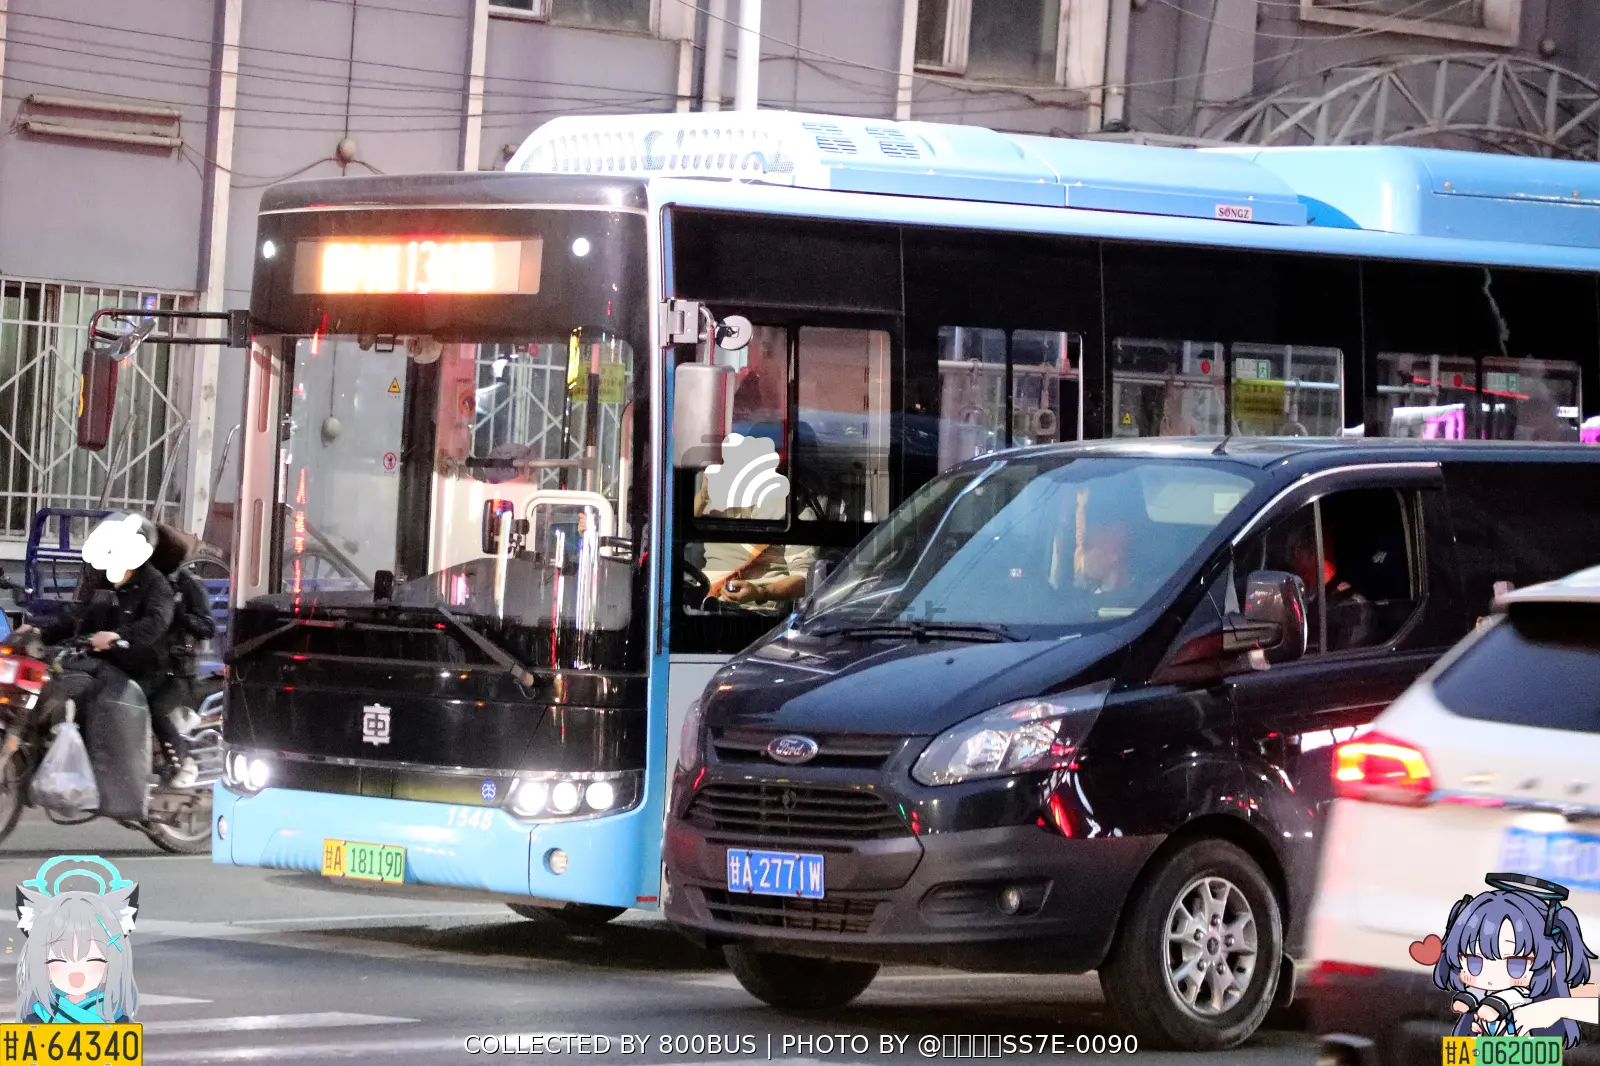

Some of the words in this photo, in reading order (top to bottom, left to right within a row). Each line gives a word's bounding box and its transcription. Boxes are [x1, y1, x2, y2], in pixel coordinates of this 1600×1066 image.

[1218, 207, 1250, 219] SONGZ
[773, 737, 808, 758] Ford
[445, 805, 496, 831] 1548
